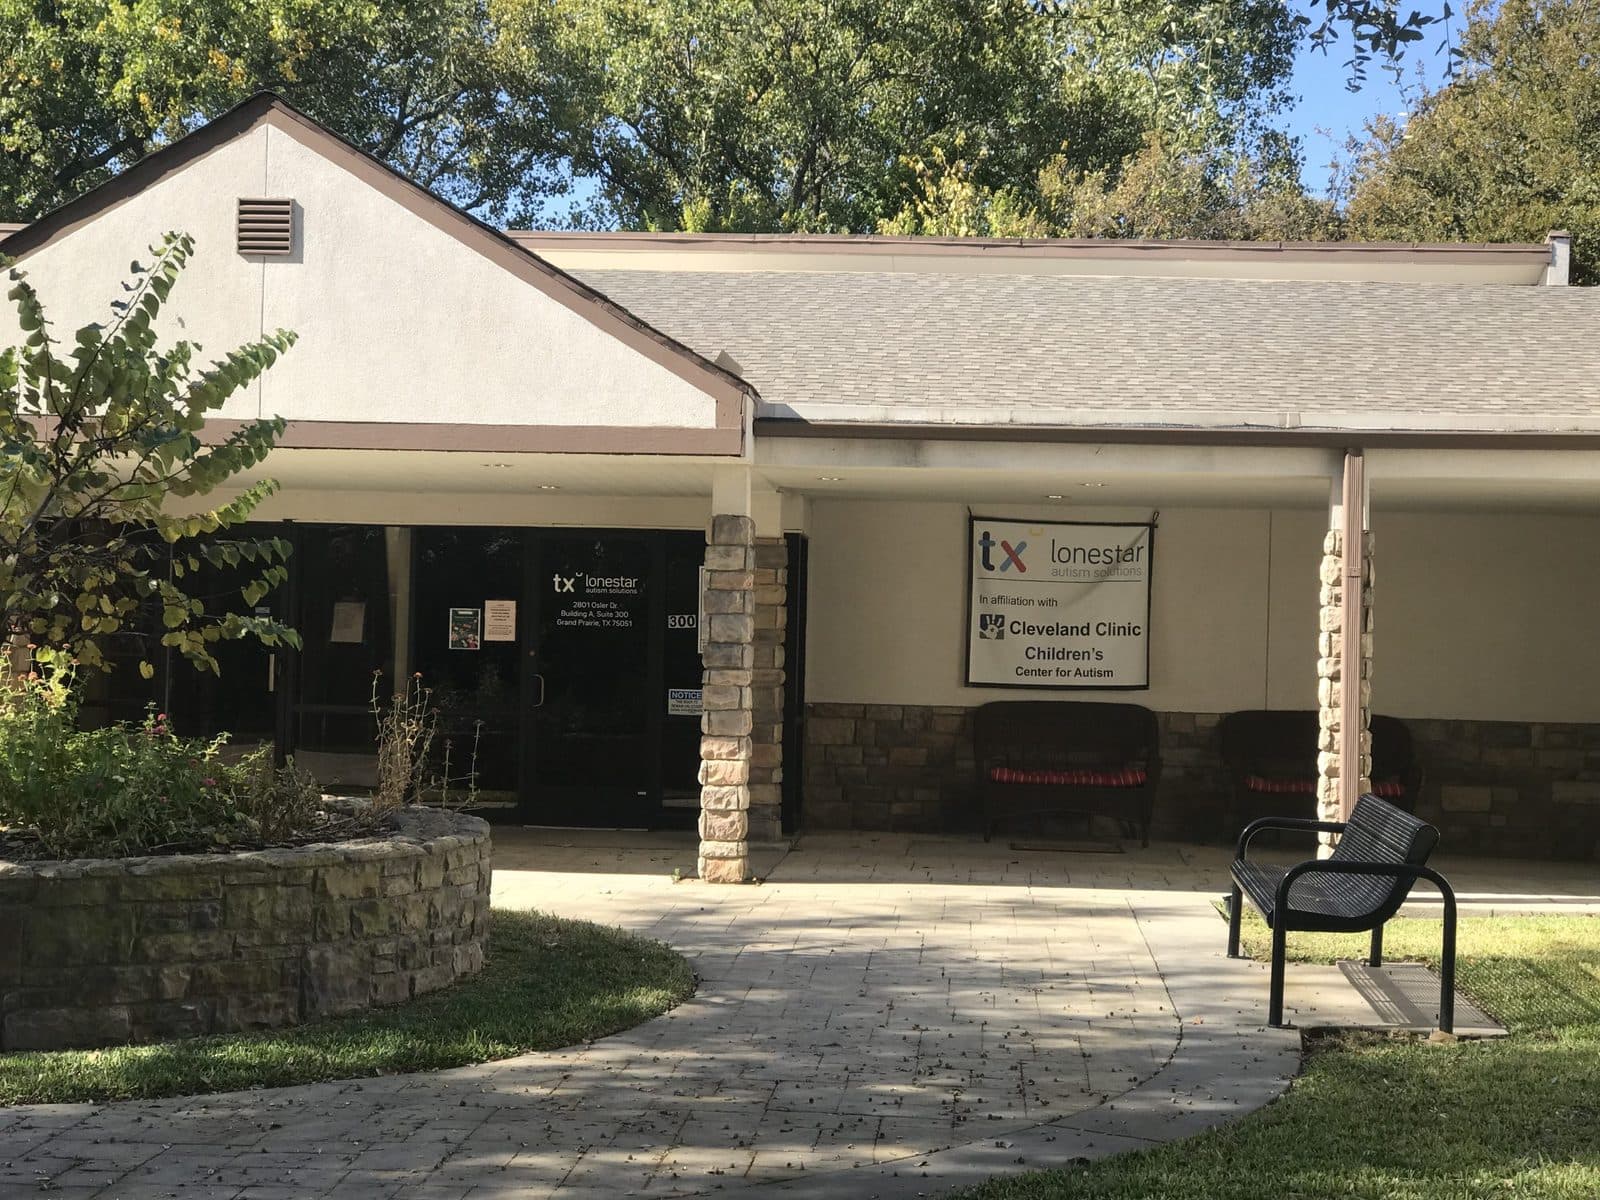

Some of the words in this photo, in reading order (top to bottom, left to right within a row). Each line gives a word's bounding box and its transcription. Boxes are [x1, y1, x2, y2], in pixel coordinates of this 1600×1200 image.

[978, 531, 1027, 573] tx
[1051, 539, 1144, 564] lonestar
[1051, 567, 1090, 577] autism
[1094, 566, 1142, 577] solutions
[553, 573, 575, 592] tx
[585, 574, 638, 587] lonestar
[979, 595, 988, 604] In
[991, 595, 1034, 606] affiliation
[1038, 597, 1058, 607] with
[560, 610, 587, 618] Building
[556, 618, 577, 626] Grand
[670, 615, 695, 627] 300
[1010, 621, 1090, 636] Cleveland
[1095, 622, 1141, 636] Clinic
[1025, 646, 1103, 660] Children's
[1015, 666, 1053, 677] Center
[1055, 667, 1071, 677] for
[1074, 668, 1114, 678] Autism
[671, 691, 702, 699] NOTICE
